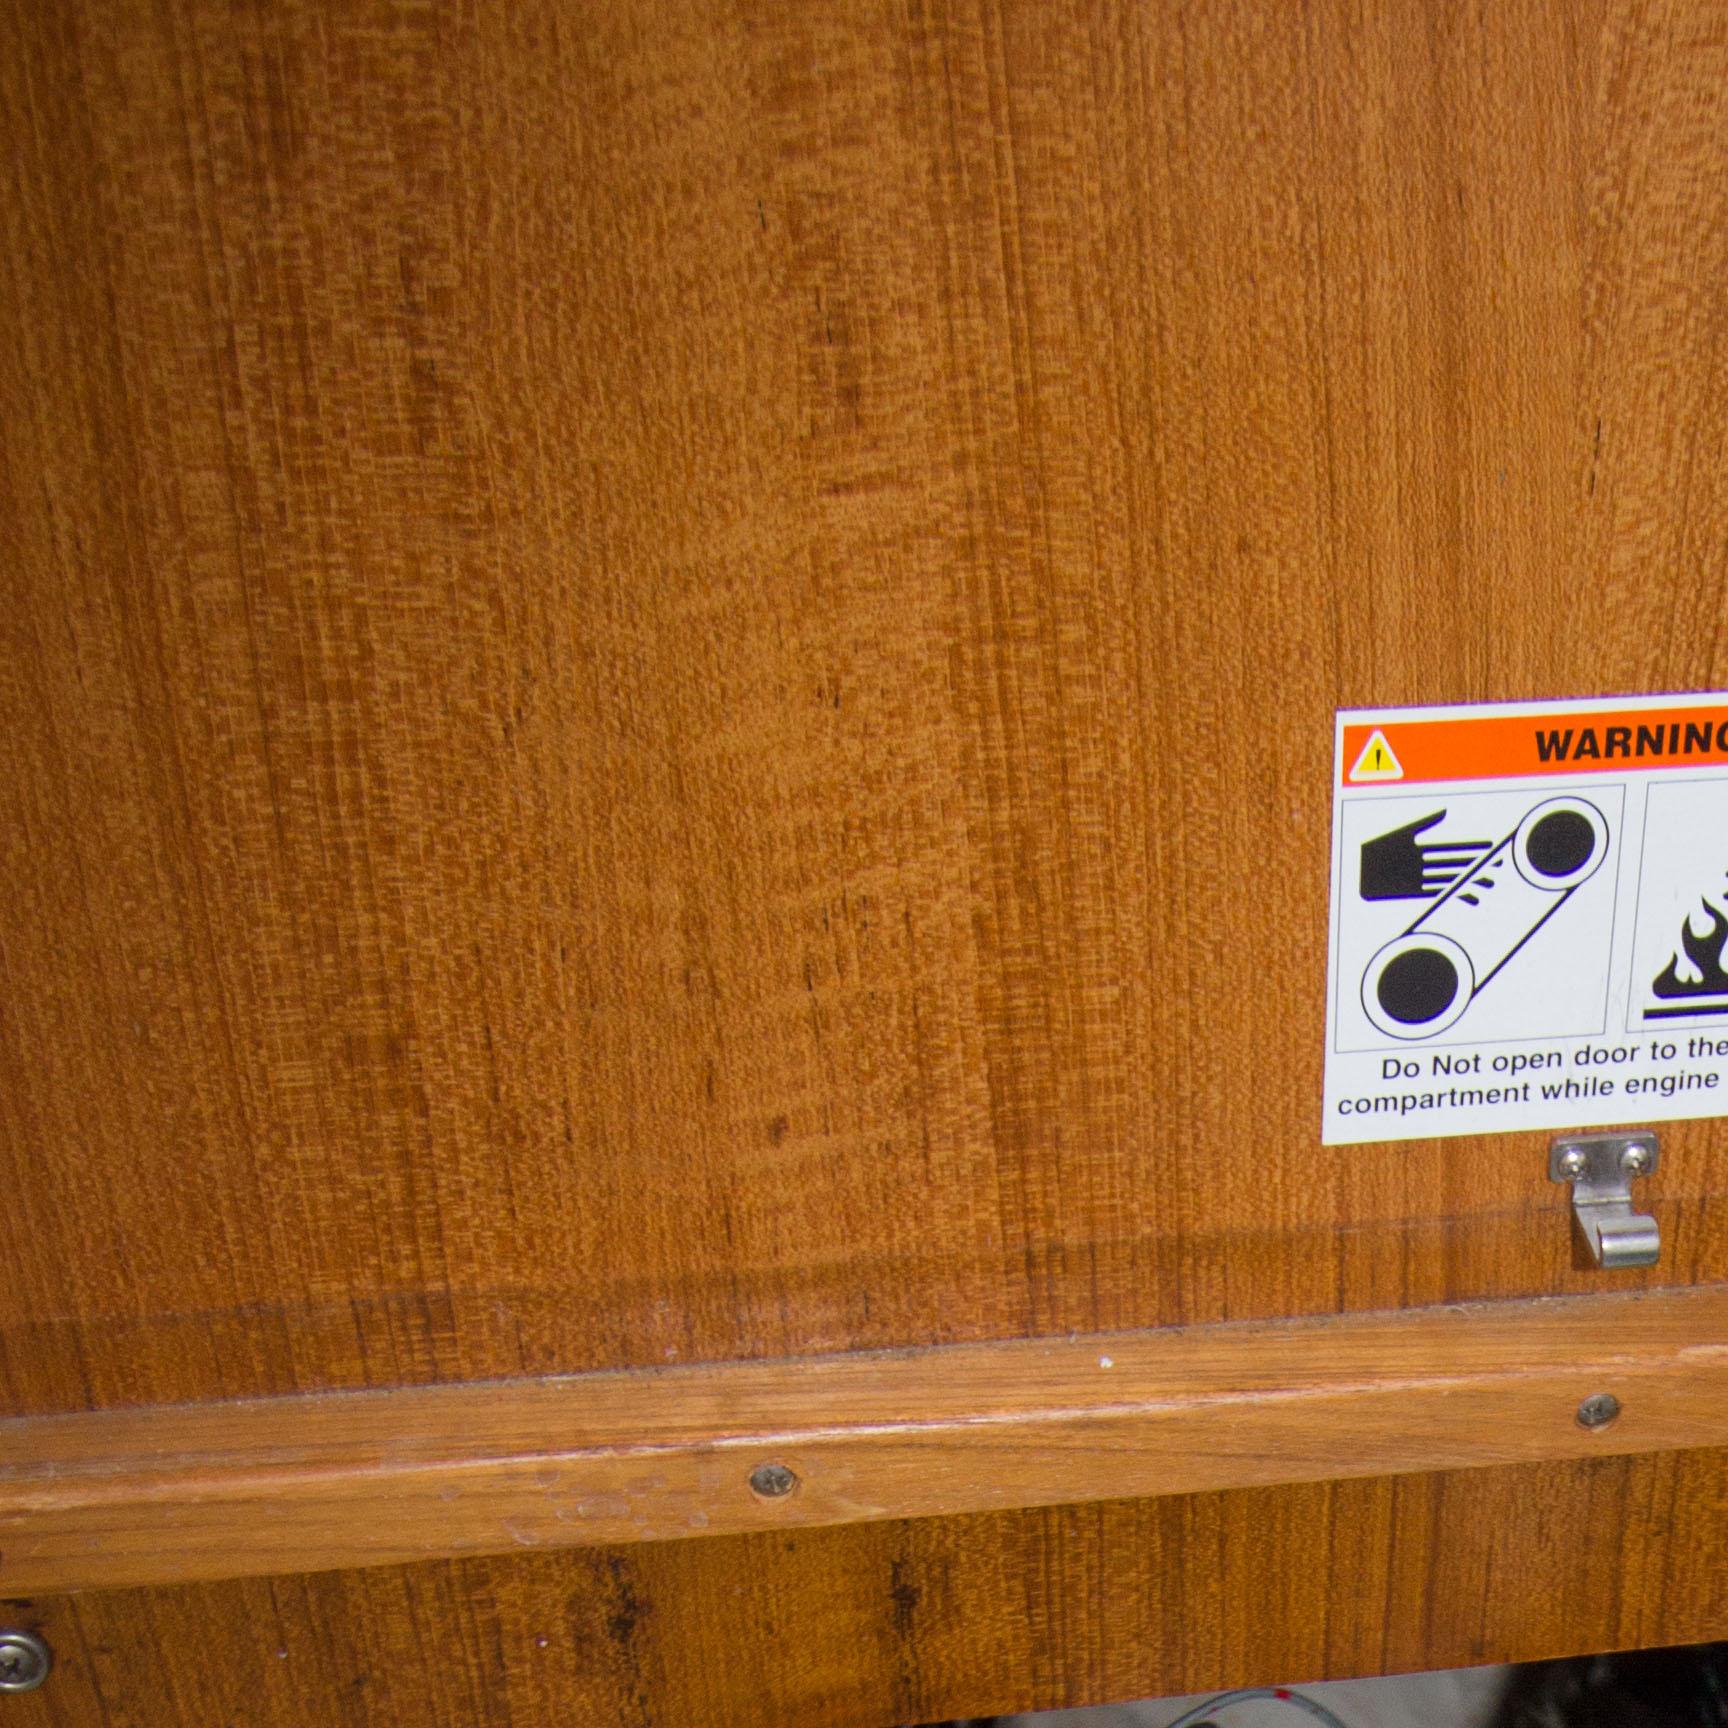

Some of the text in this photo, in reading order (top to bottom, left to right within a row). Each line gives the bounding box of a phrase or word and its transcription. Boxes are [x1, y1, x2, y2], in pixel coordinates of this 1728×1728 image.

[1382, 1058, 1420, 1080] Do
[1432, 1054, 1481, 1076] Not
[1492, 1051, 1562, 1076] open
[1574, 1045, 1640, 1066] door
[1651, 1041, 1676, 1060] to
[1338, 1083, 1530, 1116] compartment
[1541, 1077, 1614, 1101] while
[1625, 1070, 1719, 1097] engine
